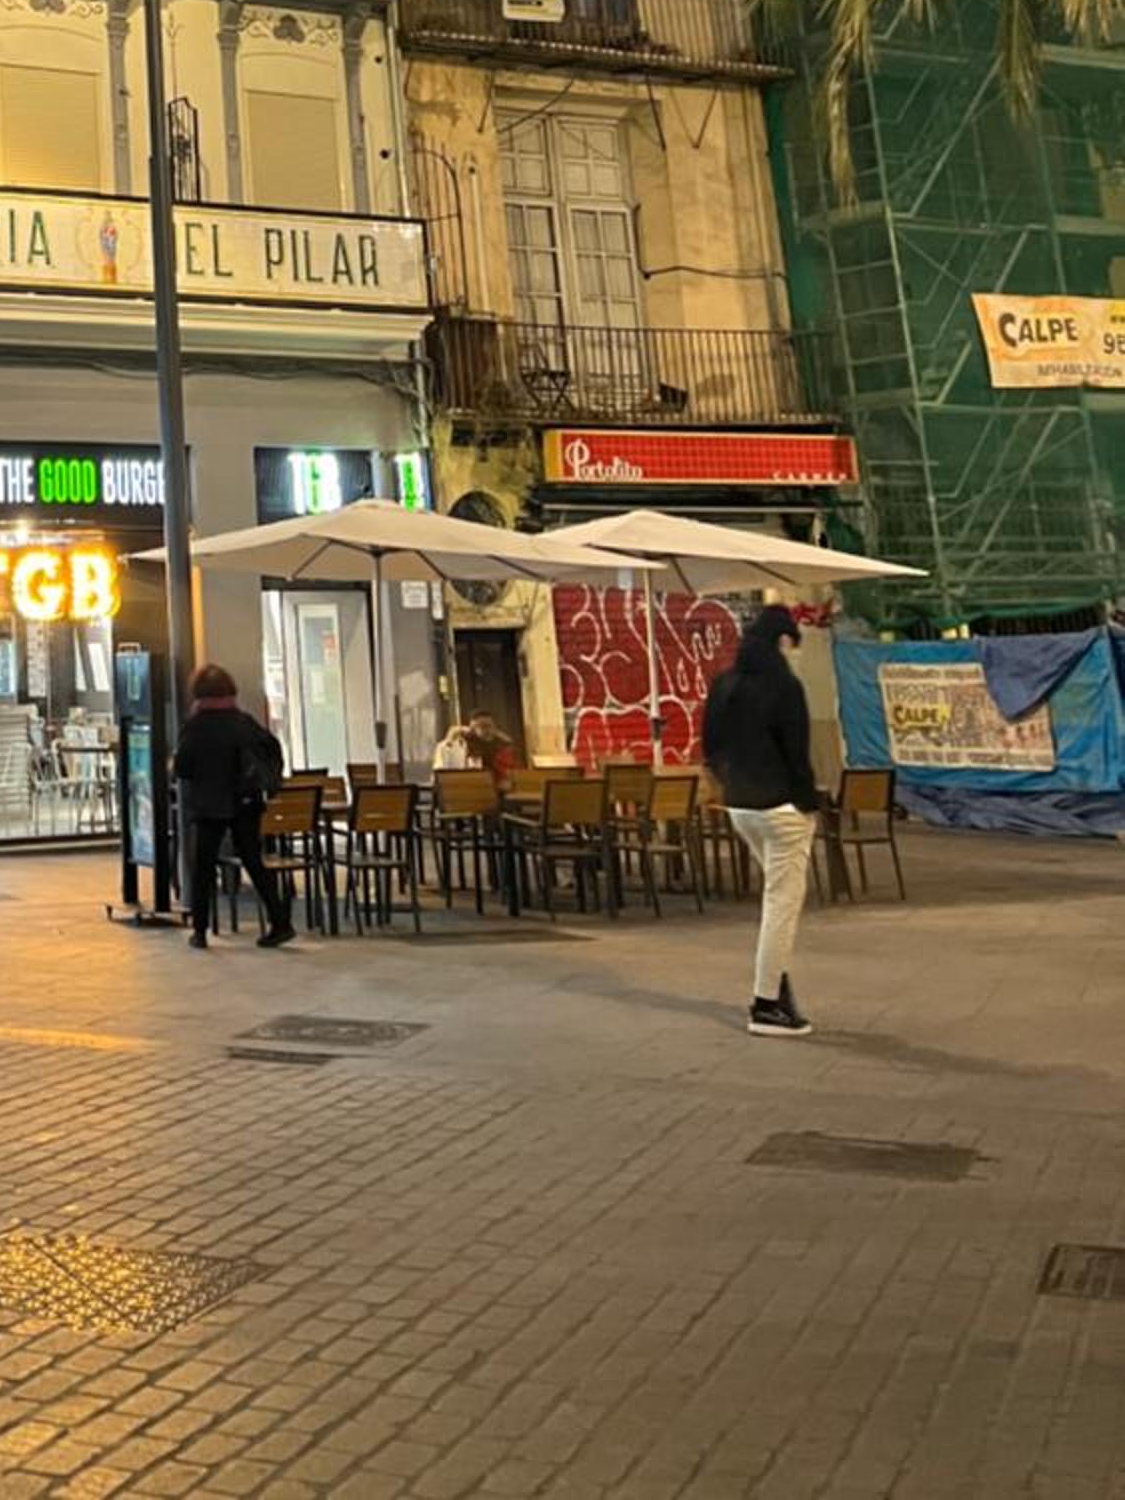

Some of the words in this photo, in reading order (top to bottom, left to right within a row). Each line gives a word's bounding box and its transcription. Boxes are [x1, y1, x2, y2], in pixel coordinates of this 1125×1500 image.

[173, 222, 234, 279] EL
[264, 227, 380, 287] PILAR
[998, 312, 1079, 348] CALPE
[38, 457, 97, 504] GOOD
[101, 459, 166, 506] BURGE
[287, 452, 342, 516] TGB
[893, 704, 939, 725] CALPE
